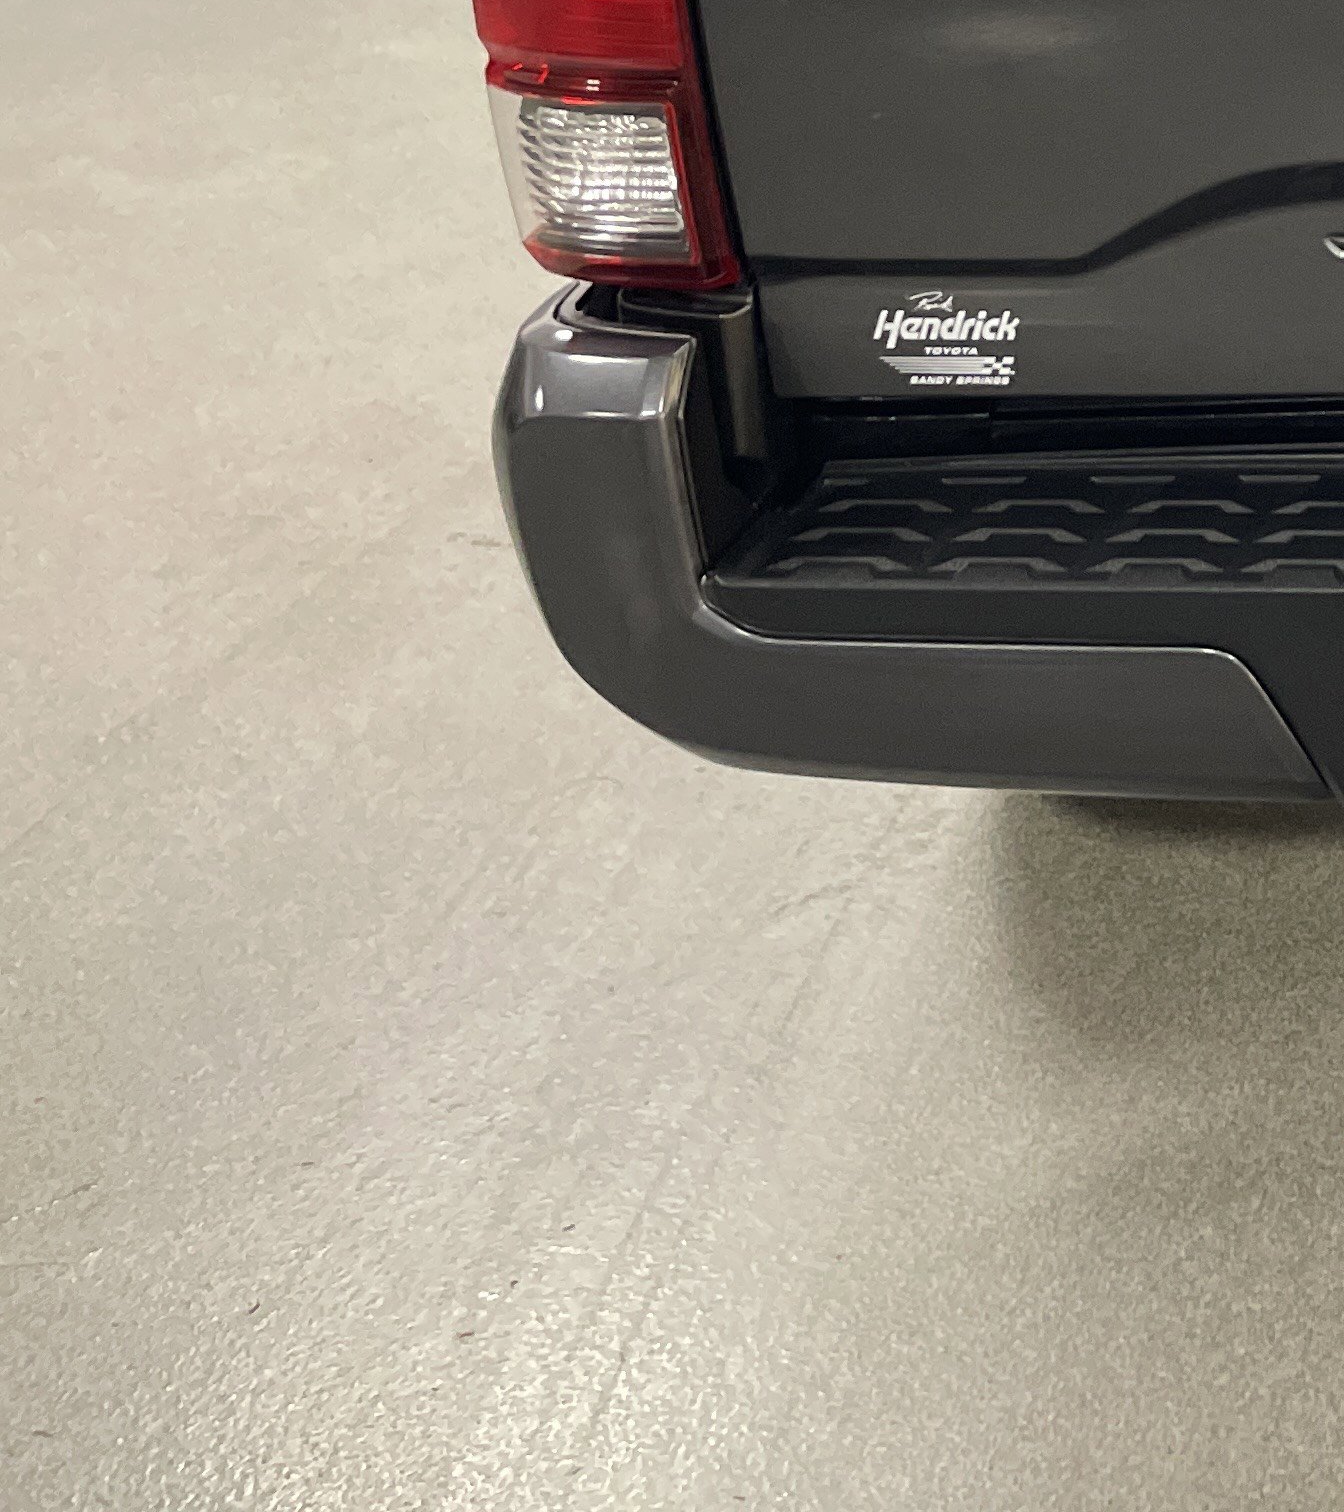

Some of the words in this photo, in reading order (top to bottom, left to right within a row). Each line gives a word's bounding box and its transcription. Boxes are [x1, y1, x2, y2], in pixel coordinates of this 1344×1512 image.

[873, 309, 1020, 349] Hendrick
[924, 346, 978, 355] TOYOTA
[910, 375, 953, 385] SANDY
[956, 375, 1010, 385] SPRINGS
